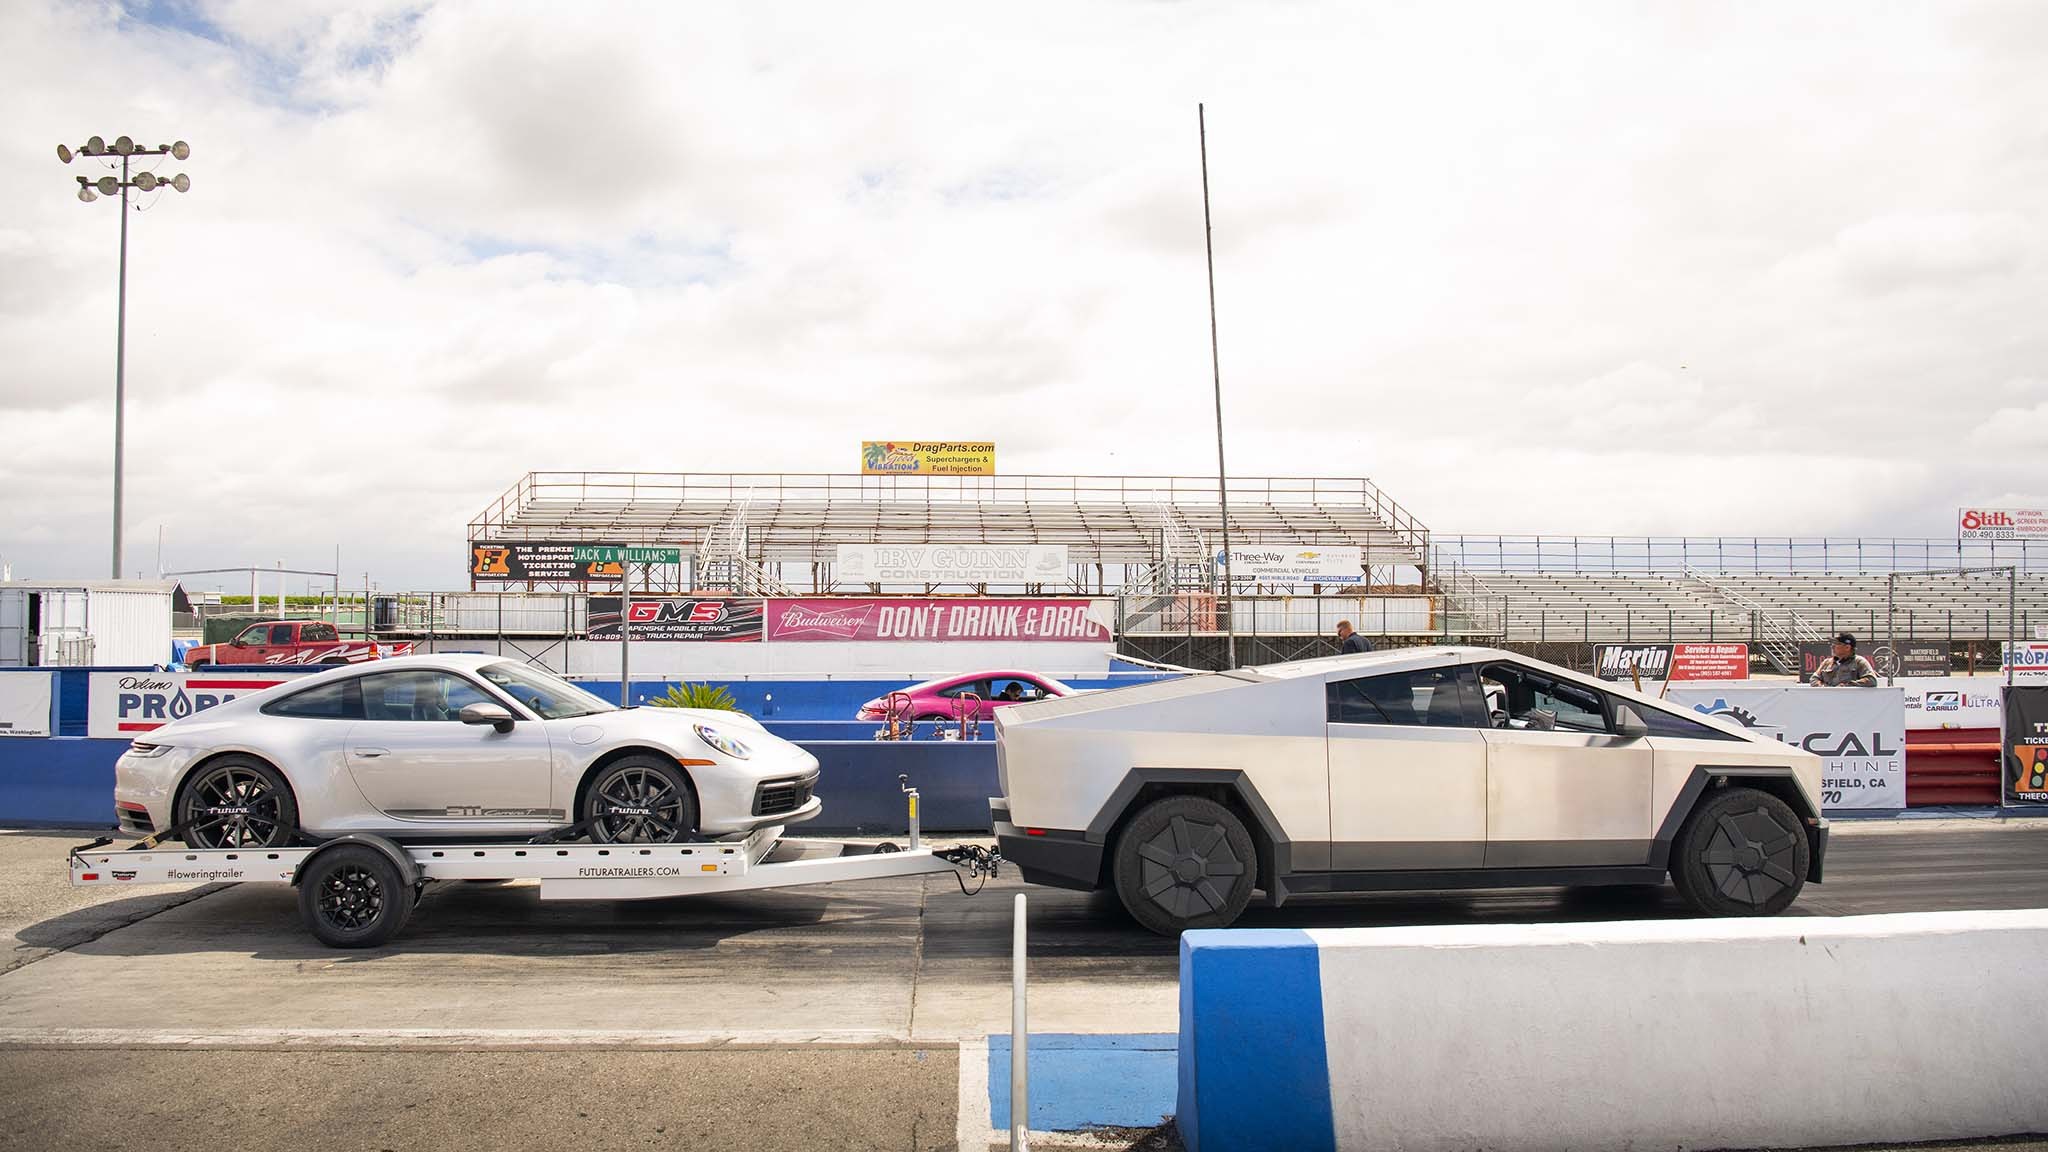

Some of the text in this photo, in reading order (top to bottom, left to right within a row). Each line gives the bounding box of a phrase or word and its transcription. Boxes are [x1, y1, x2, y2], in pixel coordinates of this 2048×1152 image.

[913, 442, 994, 454] DragParts.com
[926, 456, 981, 464] Superchargers
[950, 465, 982, 473] Injection
[1962, 510, 2015, 530] Stith
[1962, 530, 2015, 539] 800.490.8333
[574, 548, 600, 561] JACK
[604, 548, 612, 561] A
[617, 549, 666, 562] WILLIAMS
[873, 547, 1030, 569] IRV GUINN
[1232, 552, 1285, 565] Three-Way
[528, 570, 570, 578] SERVICE
[880, 569, 1025, 579] CONSTRUCTION
[628, 601, 724, 623] GMS
[781, 610, 864, 629] Budweiser
[877, 603, 945, 638] DON'T
[947, 606, 1018, 637] DRINK
[1024, 607, 1038, 635] &
[1684, 645, 1709, 654] Service
[1716, 645, 1739, 654] Repair
[1602, 646, 1668, 669] Martin
[1601, 666, 1665, 677] Supercargers
[119, 676, 173, 691] Delano
[1904, 703, 1922, 711] ntals
[1967, 699, 2000, 708] ULTRA
[1831, 761, 1898, 772] HINE
[1822, 778, 1886, 790] SFIELD, CA
[207, 806, 250, 815] Futura
[609, 806, 650, 815] Futura
[167, 869, 244, 881] #loweringtrailer
[579, 867, 680, 876] FUTURATRAILERS.COM
